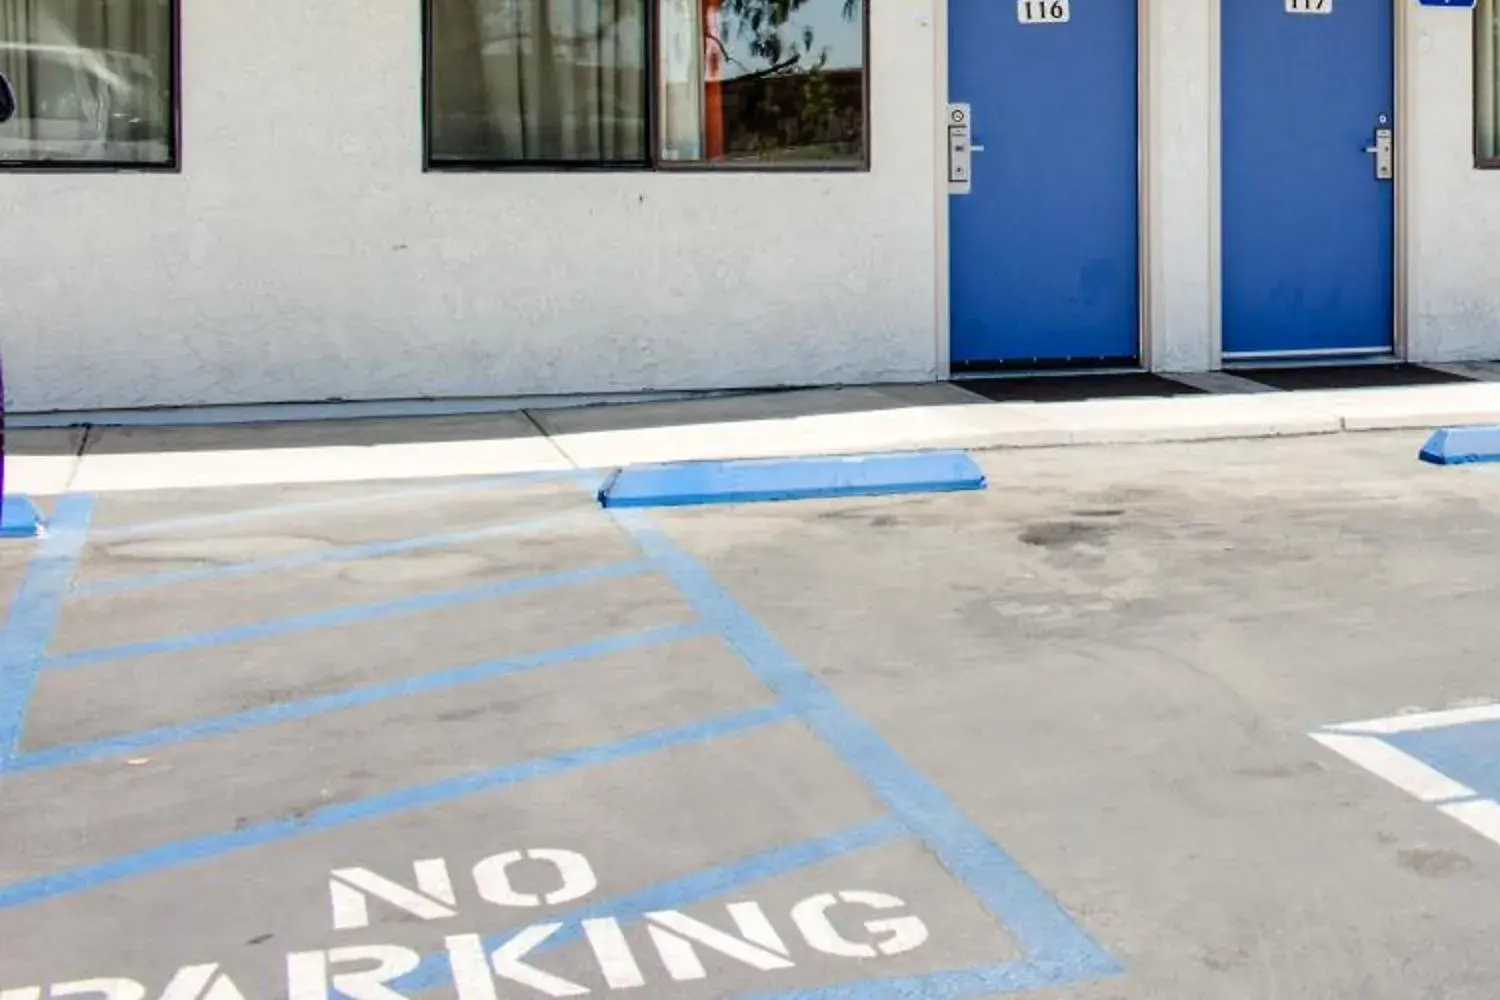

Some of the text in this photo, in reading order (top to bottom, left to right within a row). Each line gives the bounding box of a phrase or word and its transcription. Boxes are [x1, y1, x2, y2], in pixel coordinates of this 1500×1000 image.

[1023, 0, 1063, 20] 116
[328, 847, 598, 930] NO
[0, 889, 928, 1000] RKING
